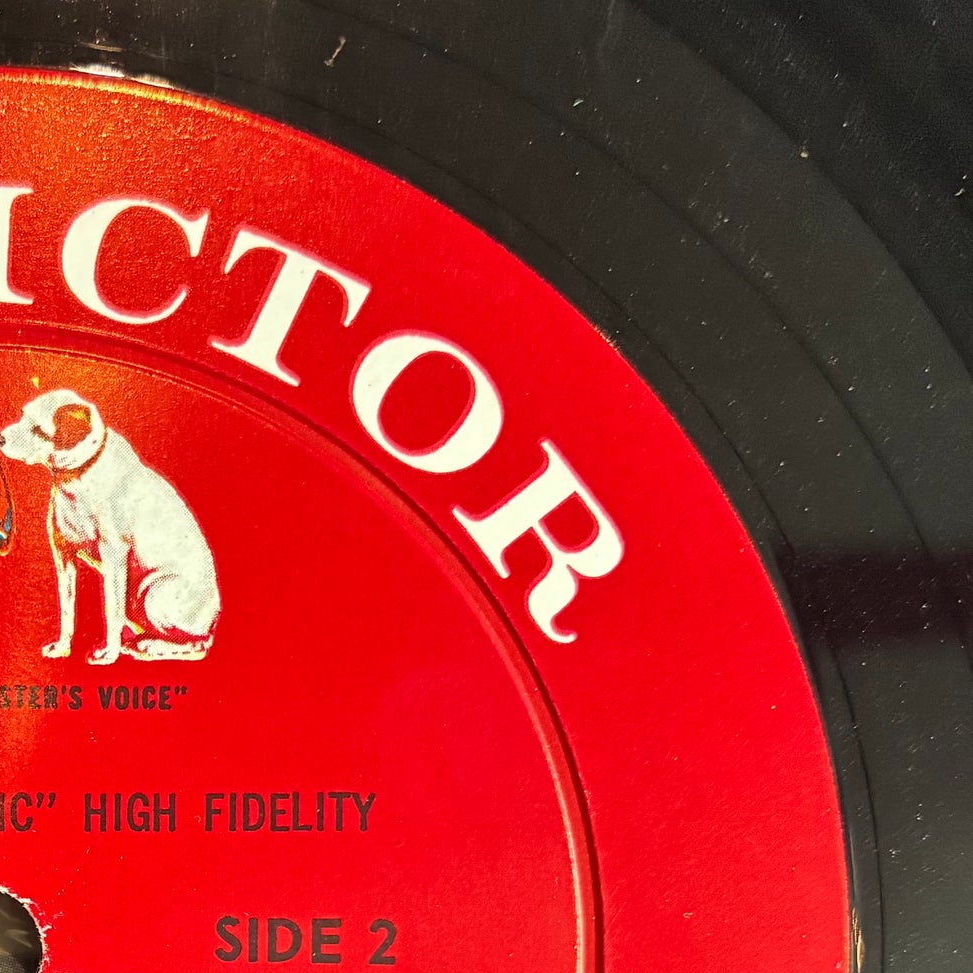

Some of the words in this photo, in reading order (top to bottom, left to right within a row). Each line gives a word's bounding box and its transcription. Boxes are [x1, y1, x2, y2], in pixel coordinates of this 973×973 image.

[83, 791, 177, 833] HIGH
[204, 790, 376, 833] FIDELITY
[214, 915, 343, 965] SIDE
[367, 917, 398, 966] 2
